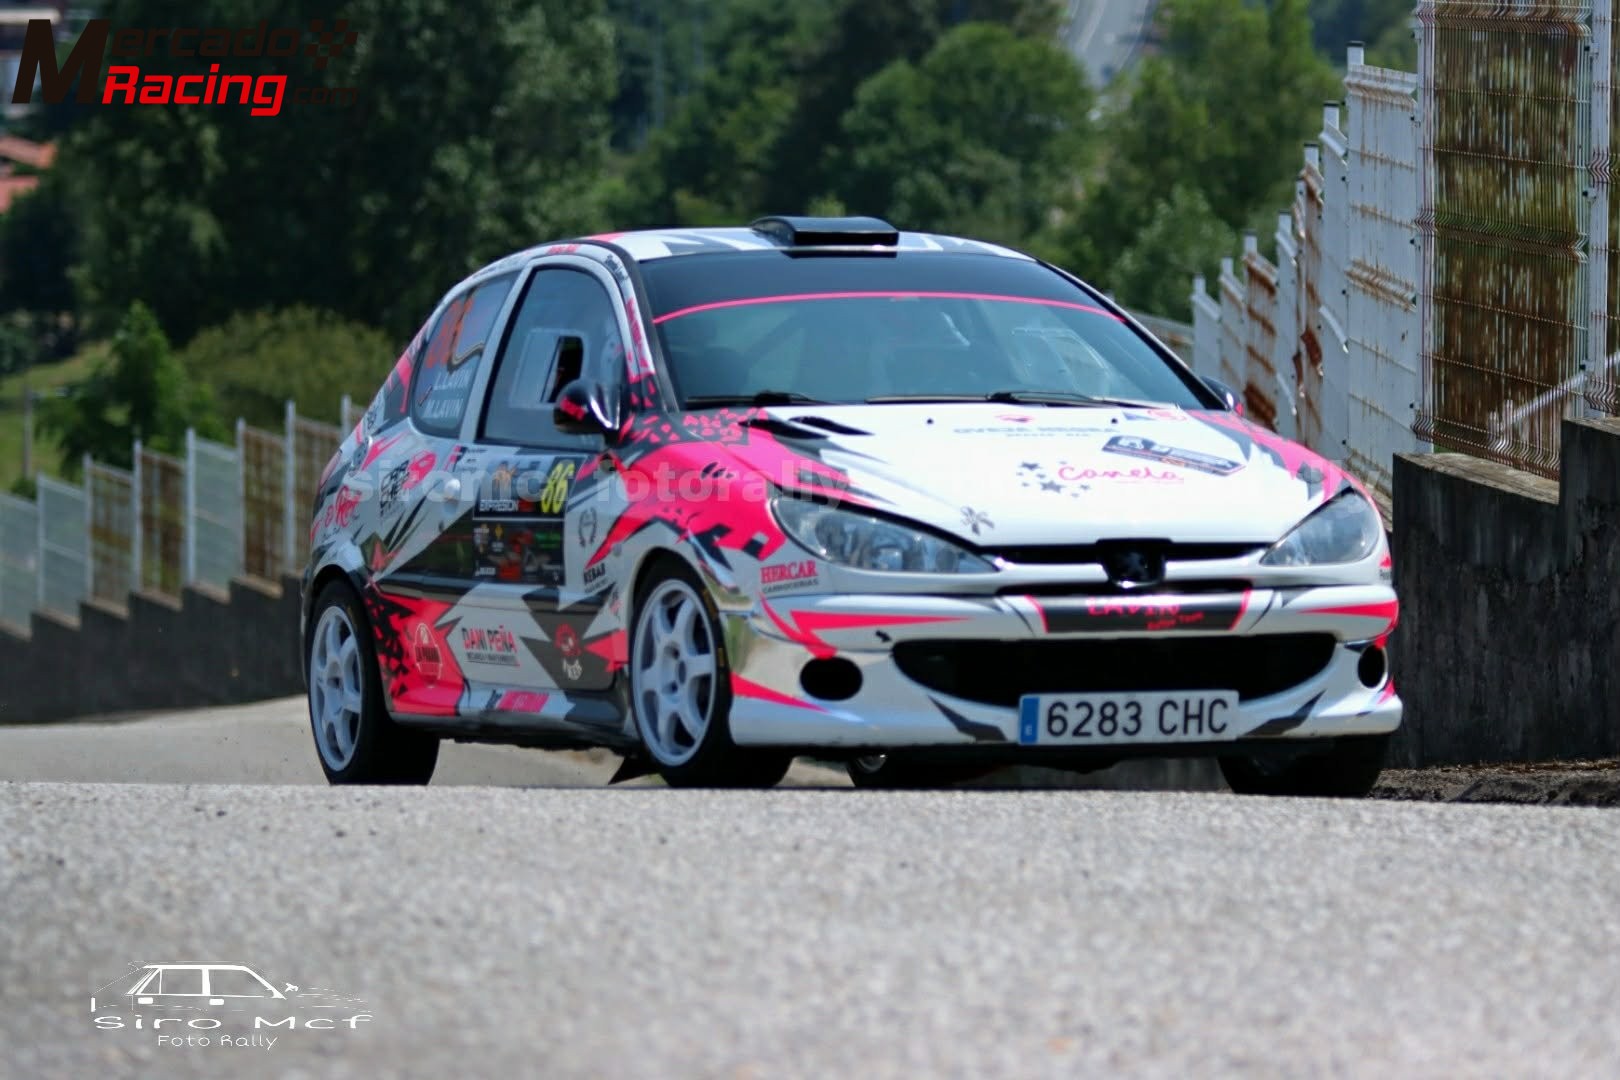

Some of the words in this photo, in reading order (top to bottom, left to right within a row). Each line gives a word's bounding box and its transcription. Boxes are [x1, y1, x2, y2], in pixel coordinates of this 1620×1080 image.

[540, 461, 576, 515] 86
[760, 559, 818, 585] HERCAR
[461, 627, 487, 652] DANI
[487, 624, 519, 654] PEÑA
[1046, 701, 1142, 738] 6283
[1158, 698, 1229, 736] CHC
